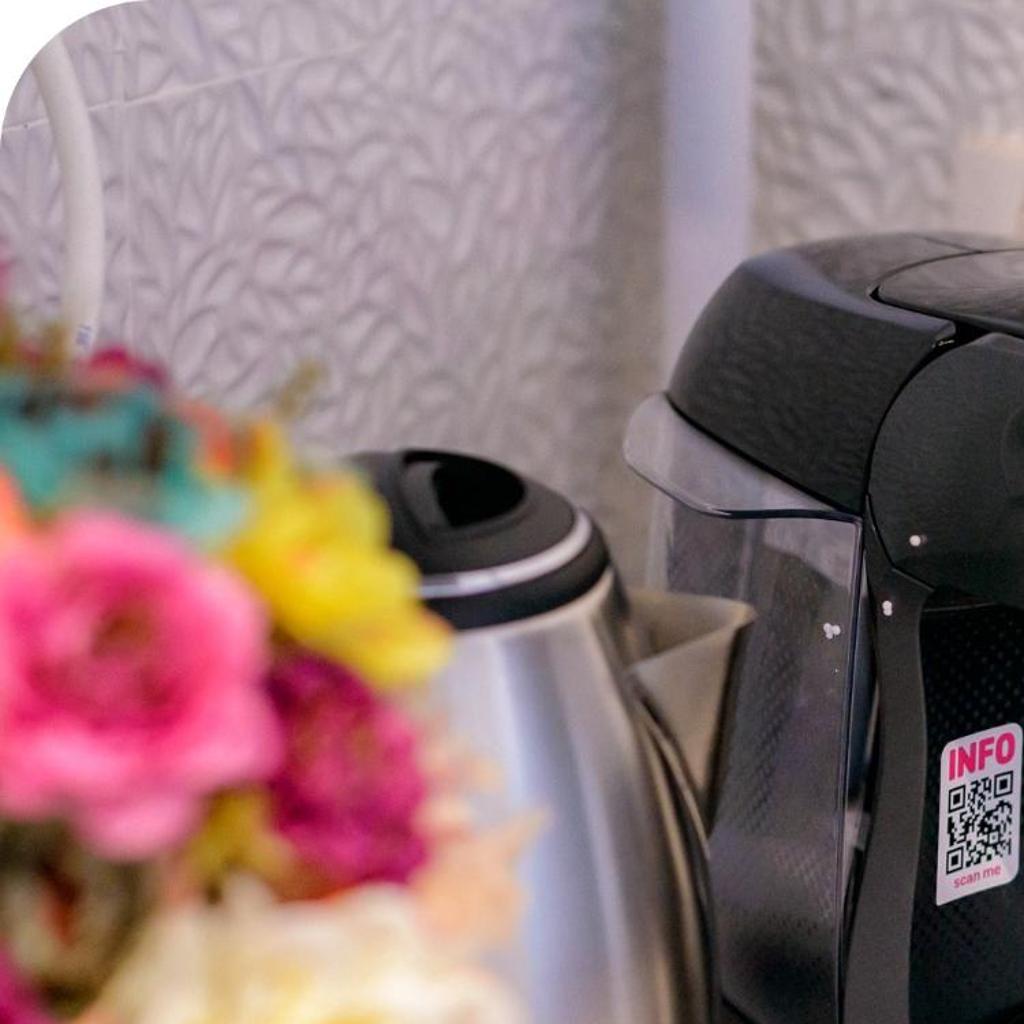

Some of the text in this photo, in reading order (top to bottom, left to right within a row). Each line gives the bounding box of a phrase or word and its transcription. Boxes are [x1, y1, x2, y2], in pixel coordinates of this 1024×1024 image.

[948, 732, 1015, 781] INFO
[953, 865, 1001, 889] scan me
